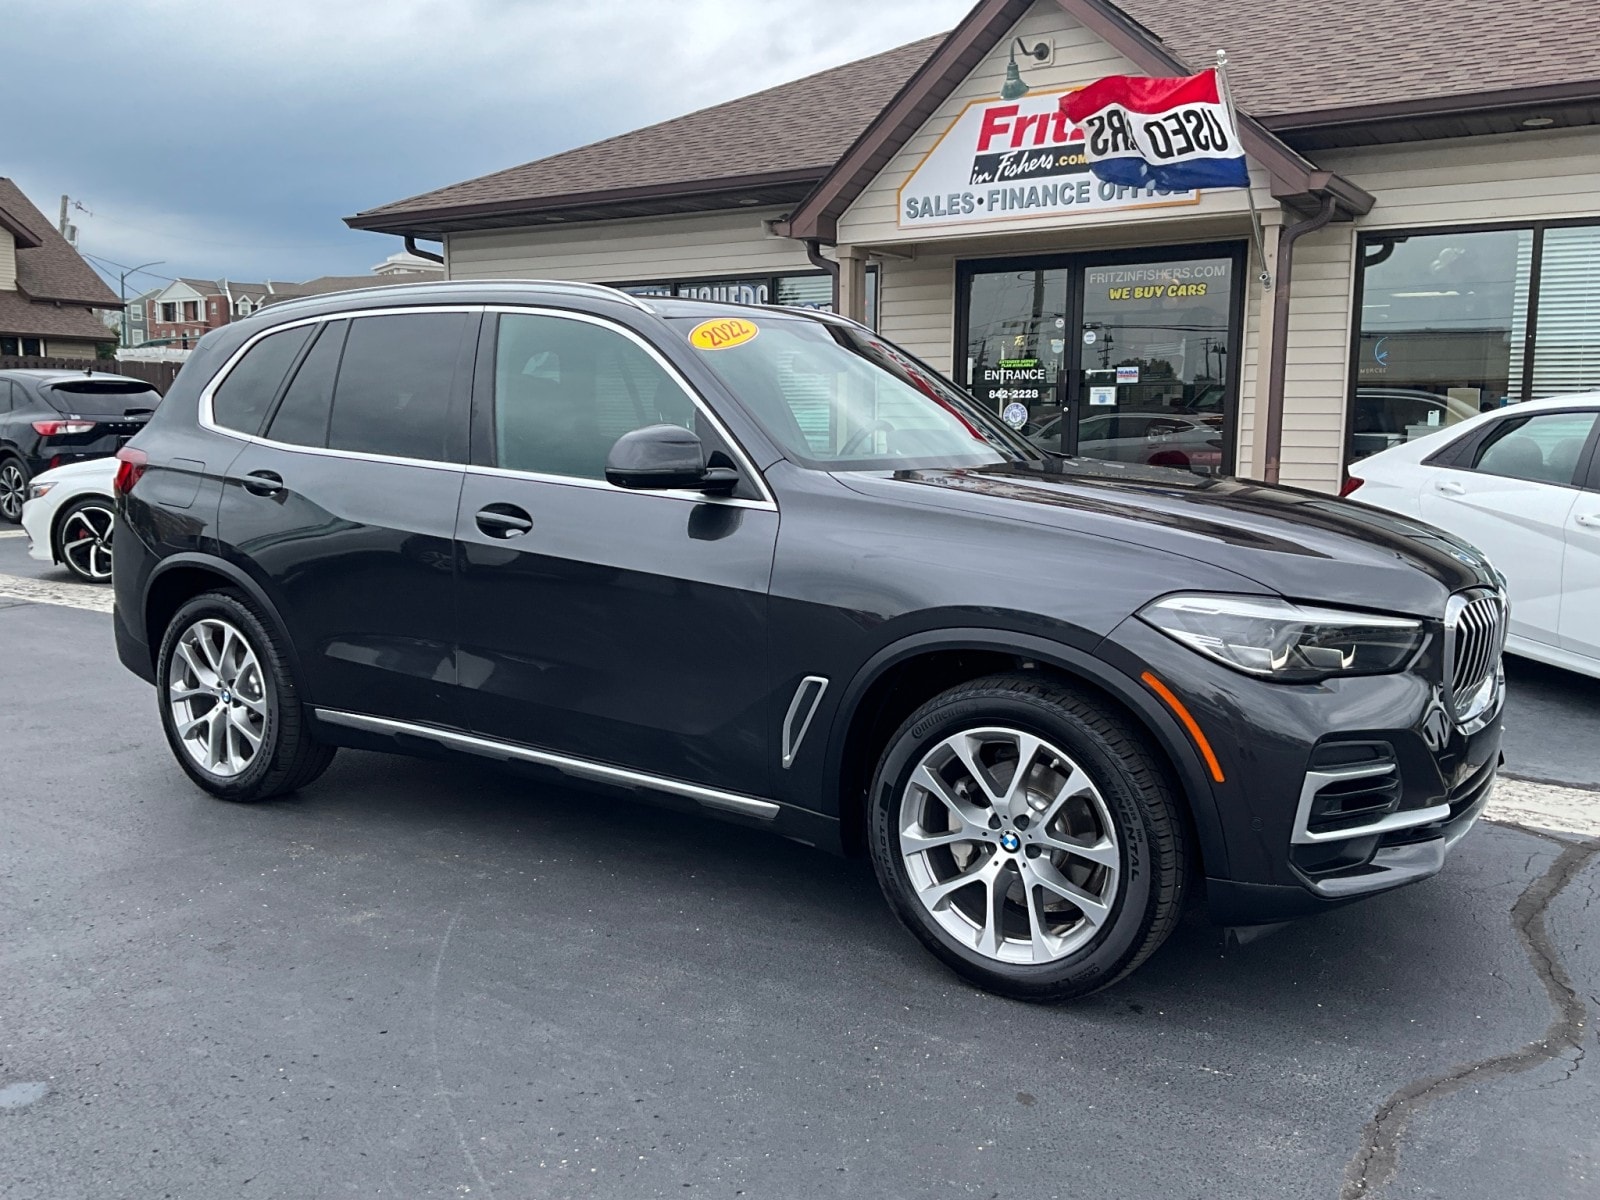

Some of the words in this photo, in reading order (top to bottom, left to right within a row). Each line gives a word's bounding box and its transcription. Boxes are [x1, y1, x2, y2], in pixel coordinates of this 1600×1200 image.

[970, 165, 992, 185] in
[998, 152, 1054, 184] Fishers
[905, 192, 975, 219] SALES
[987, 180, 1091, 212] FINANCE
[1089, 265, 1226, 284] FRITZINFISHERS.COM
[1109, 287, 1131, 300] WE
[1134, 285, 1164, 299] BUY
[1167, 283, 1208, 297] CARS
[701, 320, 750, 347] 2022
[984, 368, 1045, 381] ENTRANCE
[988, 388, 1039, 399] 842-2228
